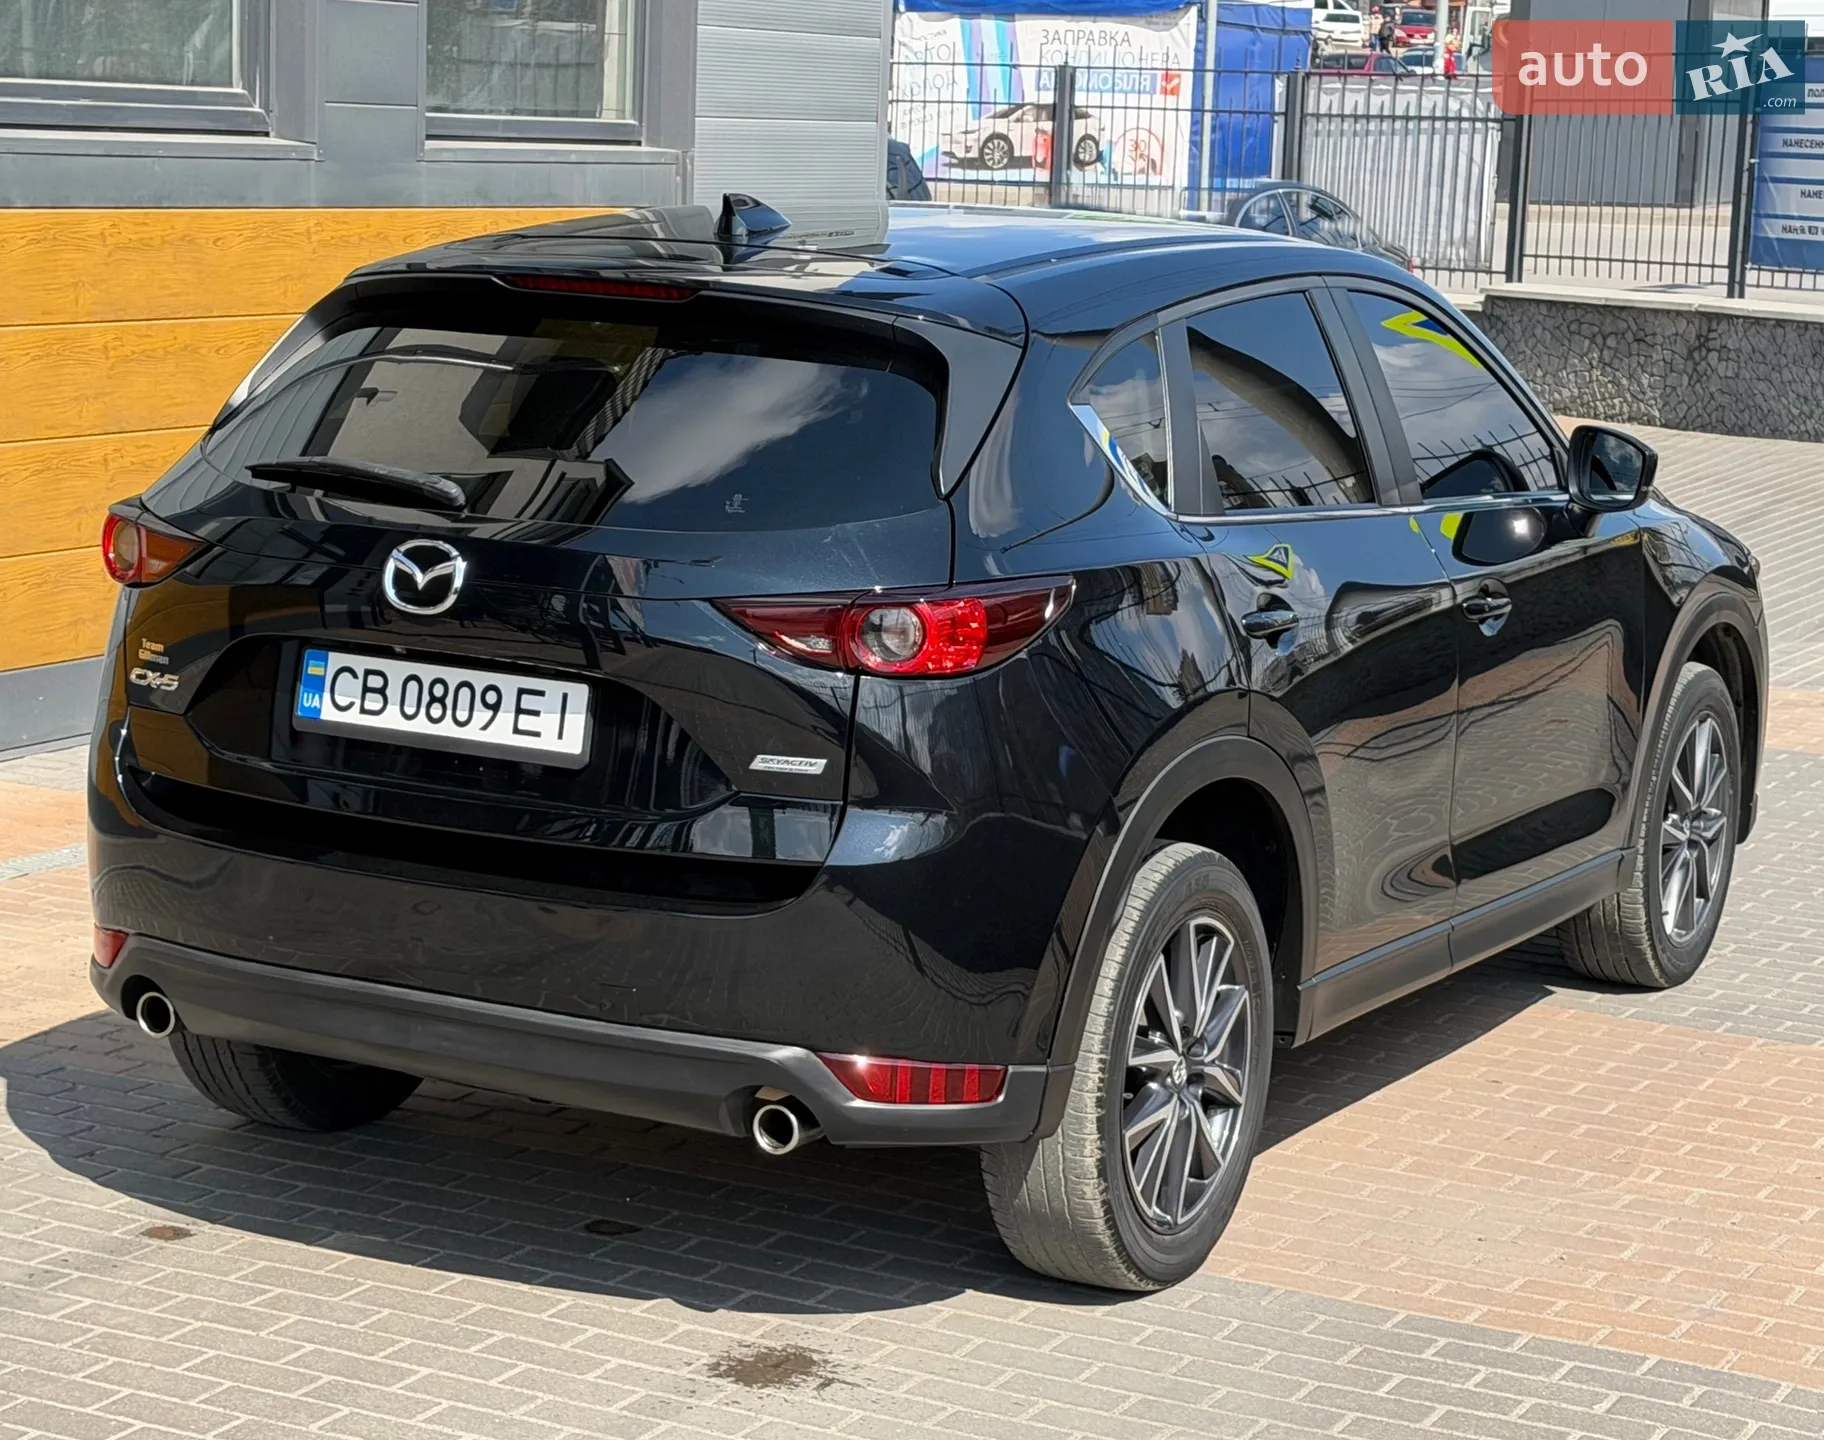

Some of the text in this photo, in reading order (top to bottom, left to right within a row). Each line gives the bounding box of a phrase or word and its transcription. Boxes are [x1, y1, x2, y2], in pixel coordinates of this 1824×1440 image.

[1041, 28, 1132, 47] ЗАПРАВКА
[1039, 71, 1150, 92] АОМОБІЛЯ
[130, 667, 179, 691] CX-5
[302, 692, 321, 709] UA
[759, 757, 818, 768] SKYACTIV
